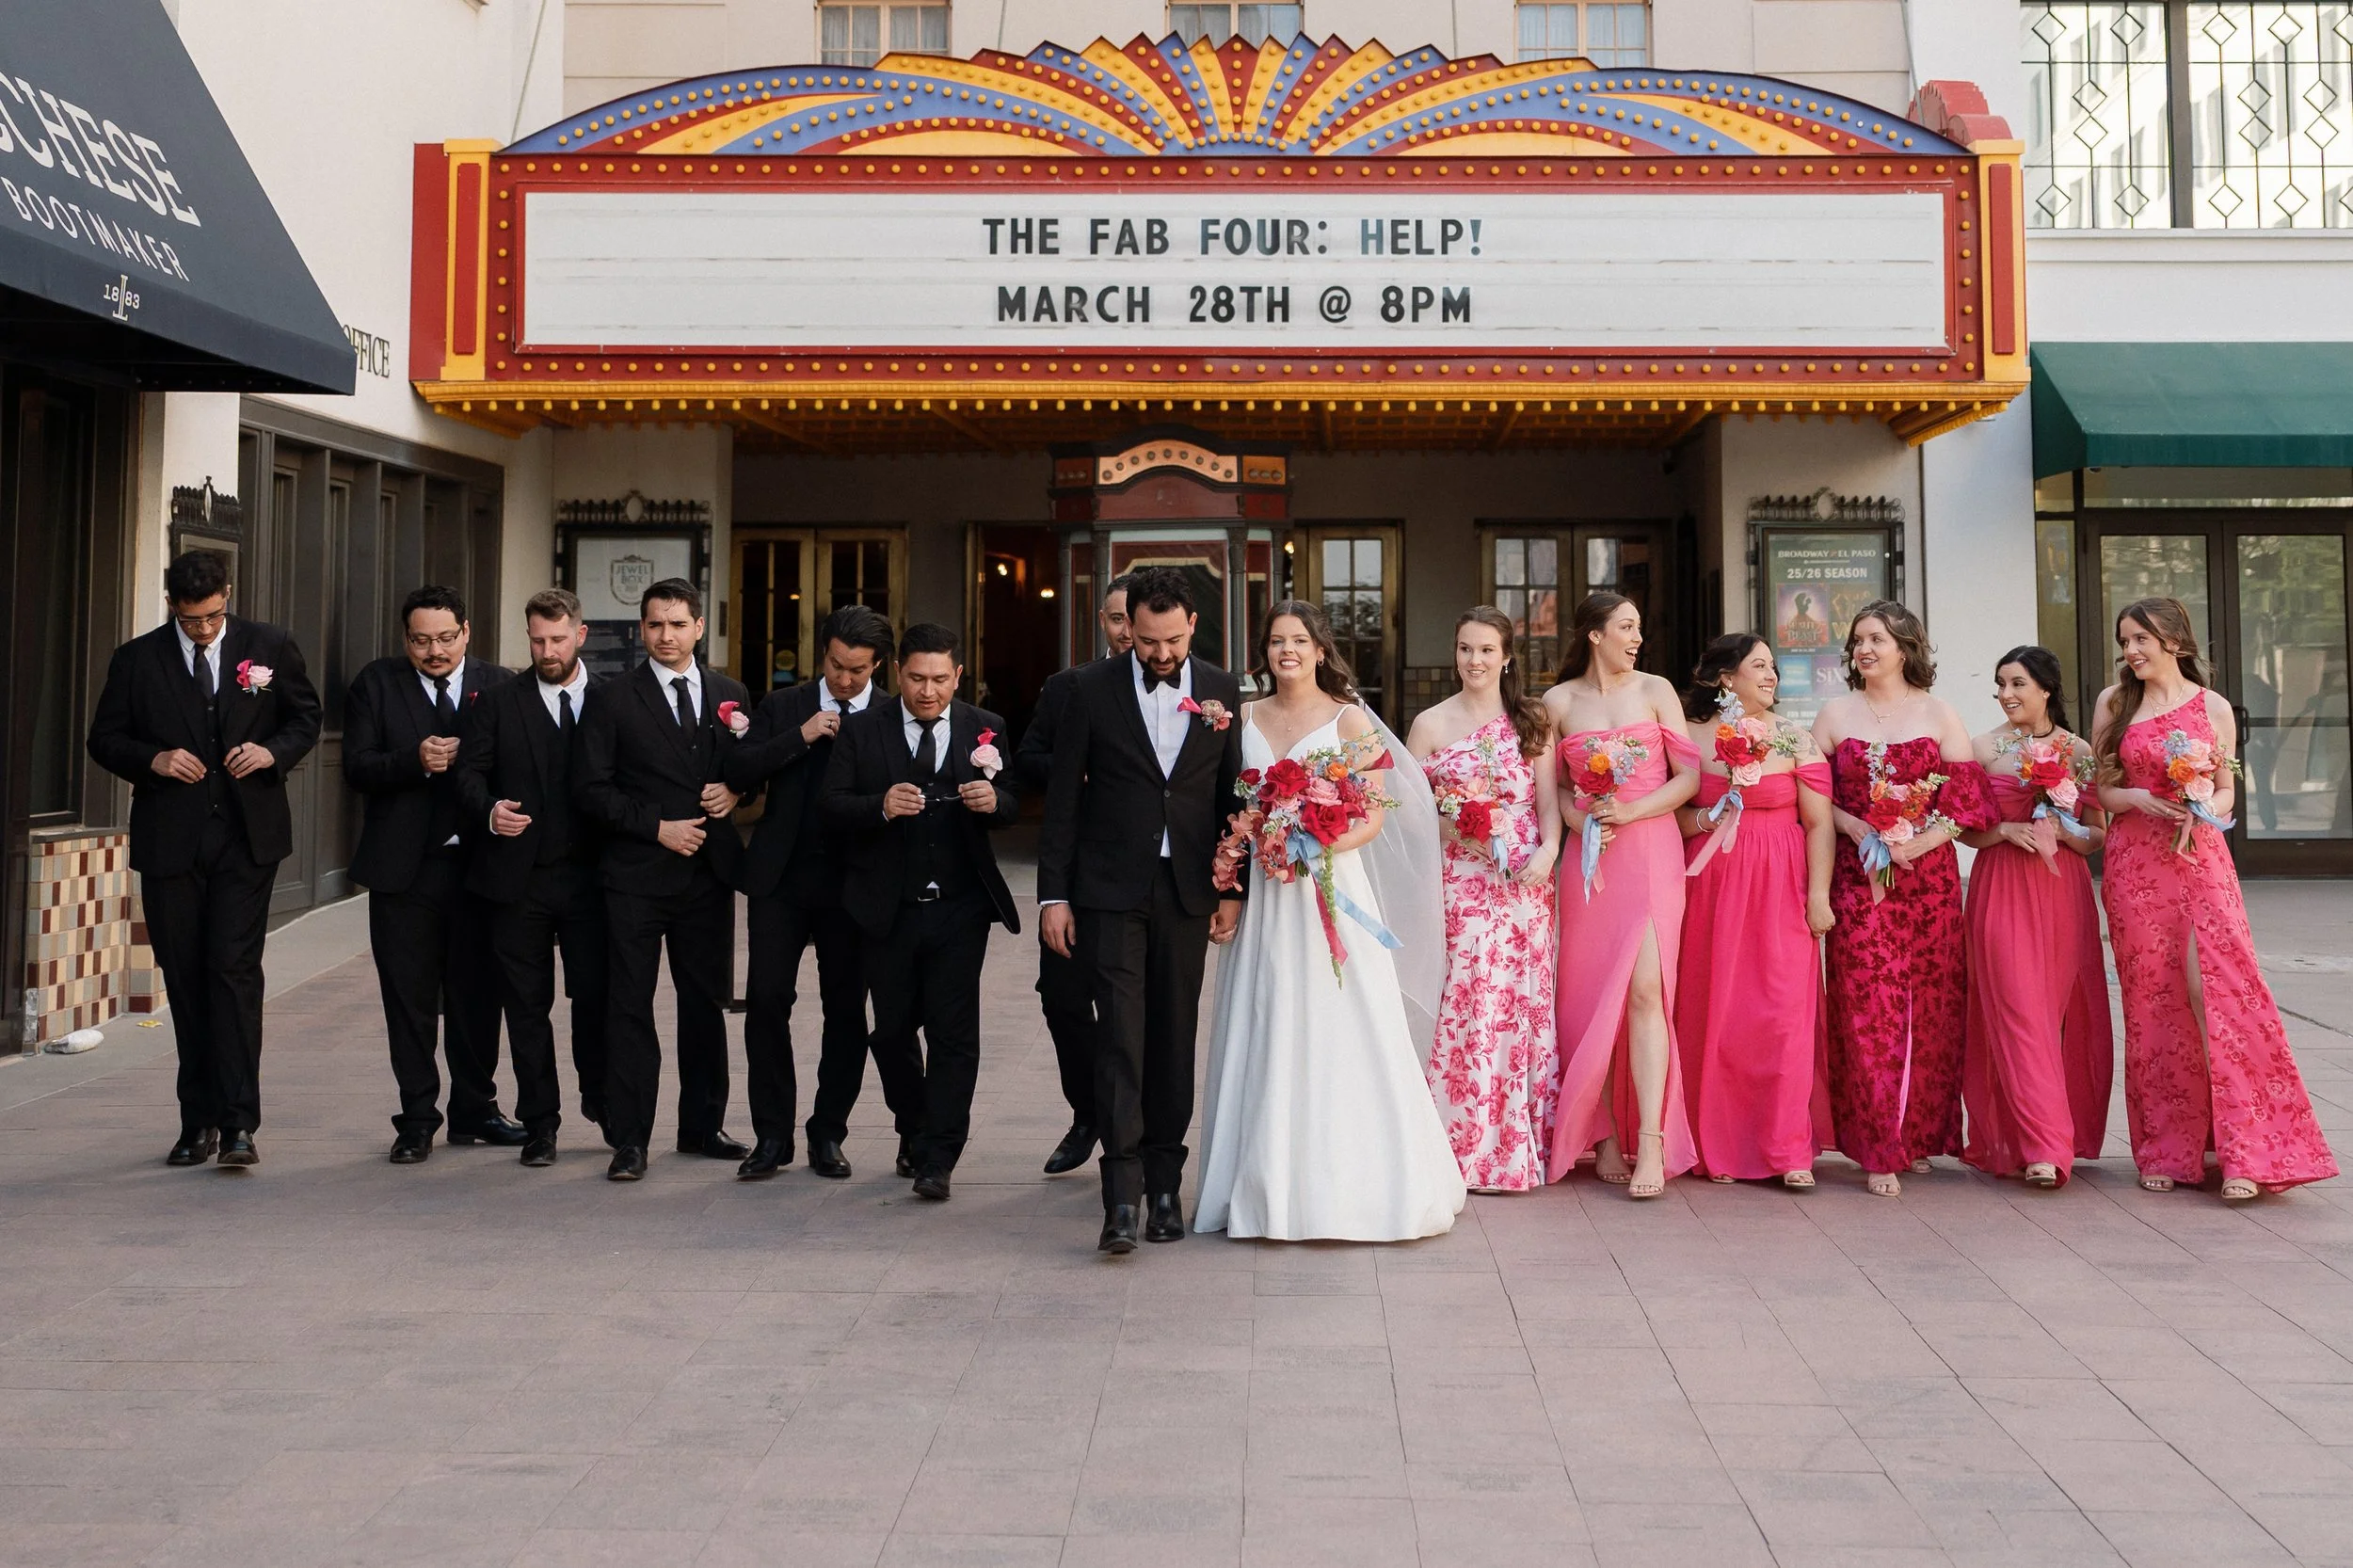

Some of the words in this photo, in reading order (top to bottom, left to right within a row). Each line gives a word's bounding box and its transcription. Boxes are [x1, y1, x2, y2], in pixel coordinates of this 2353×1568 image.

[0, 72, 200, 227] CHESE
[1, 176, 190, 282] BOOTMAKER
[983, 217, 1060, 255] THE
[1090, 217, 1169, 255] FAB
[1200, 217, 1328, 255] FOUR:
[1361, 217, 1481, 255] HELP!
[998, 285, 1150, 324] MARCH
[1189, 285, 1290, 324] 28TH
[1319, 285, 1352, 324] @
[1381, 285, 1470, 324] 8PM
[616, 565, 648, 574] JEWEL
[1777, 550, 1830, 558] BROADWAY
[1838, 550, 1849, 558] EL
[1851, 550, 1877, 558] PASO
[1786, 568, 1822, 579] 25/26
[1824, 568, 1868, 579] SEASON
